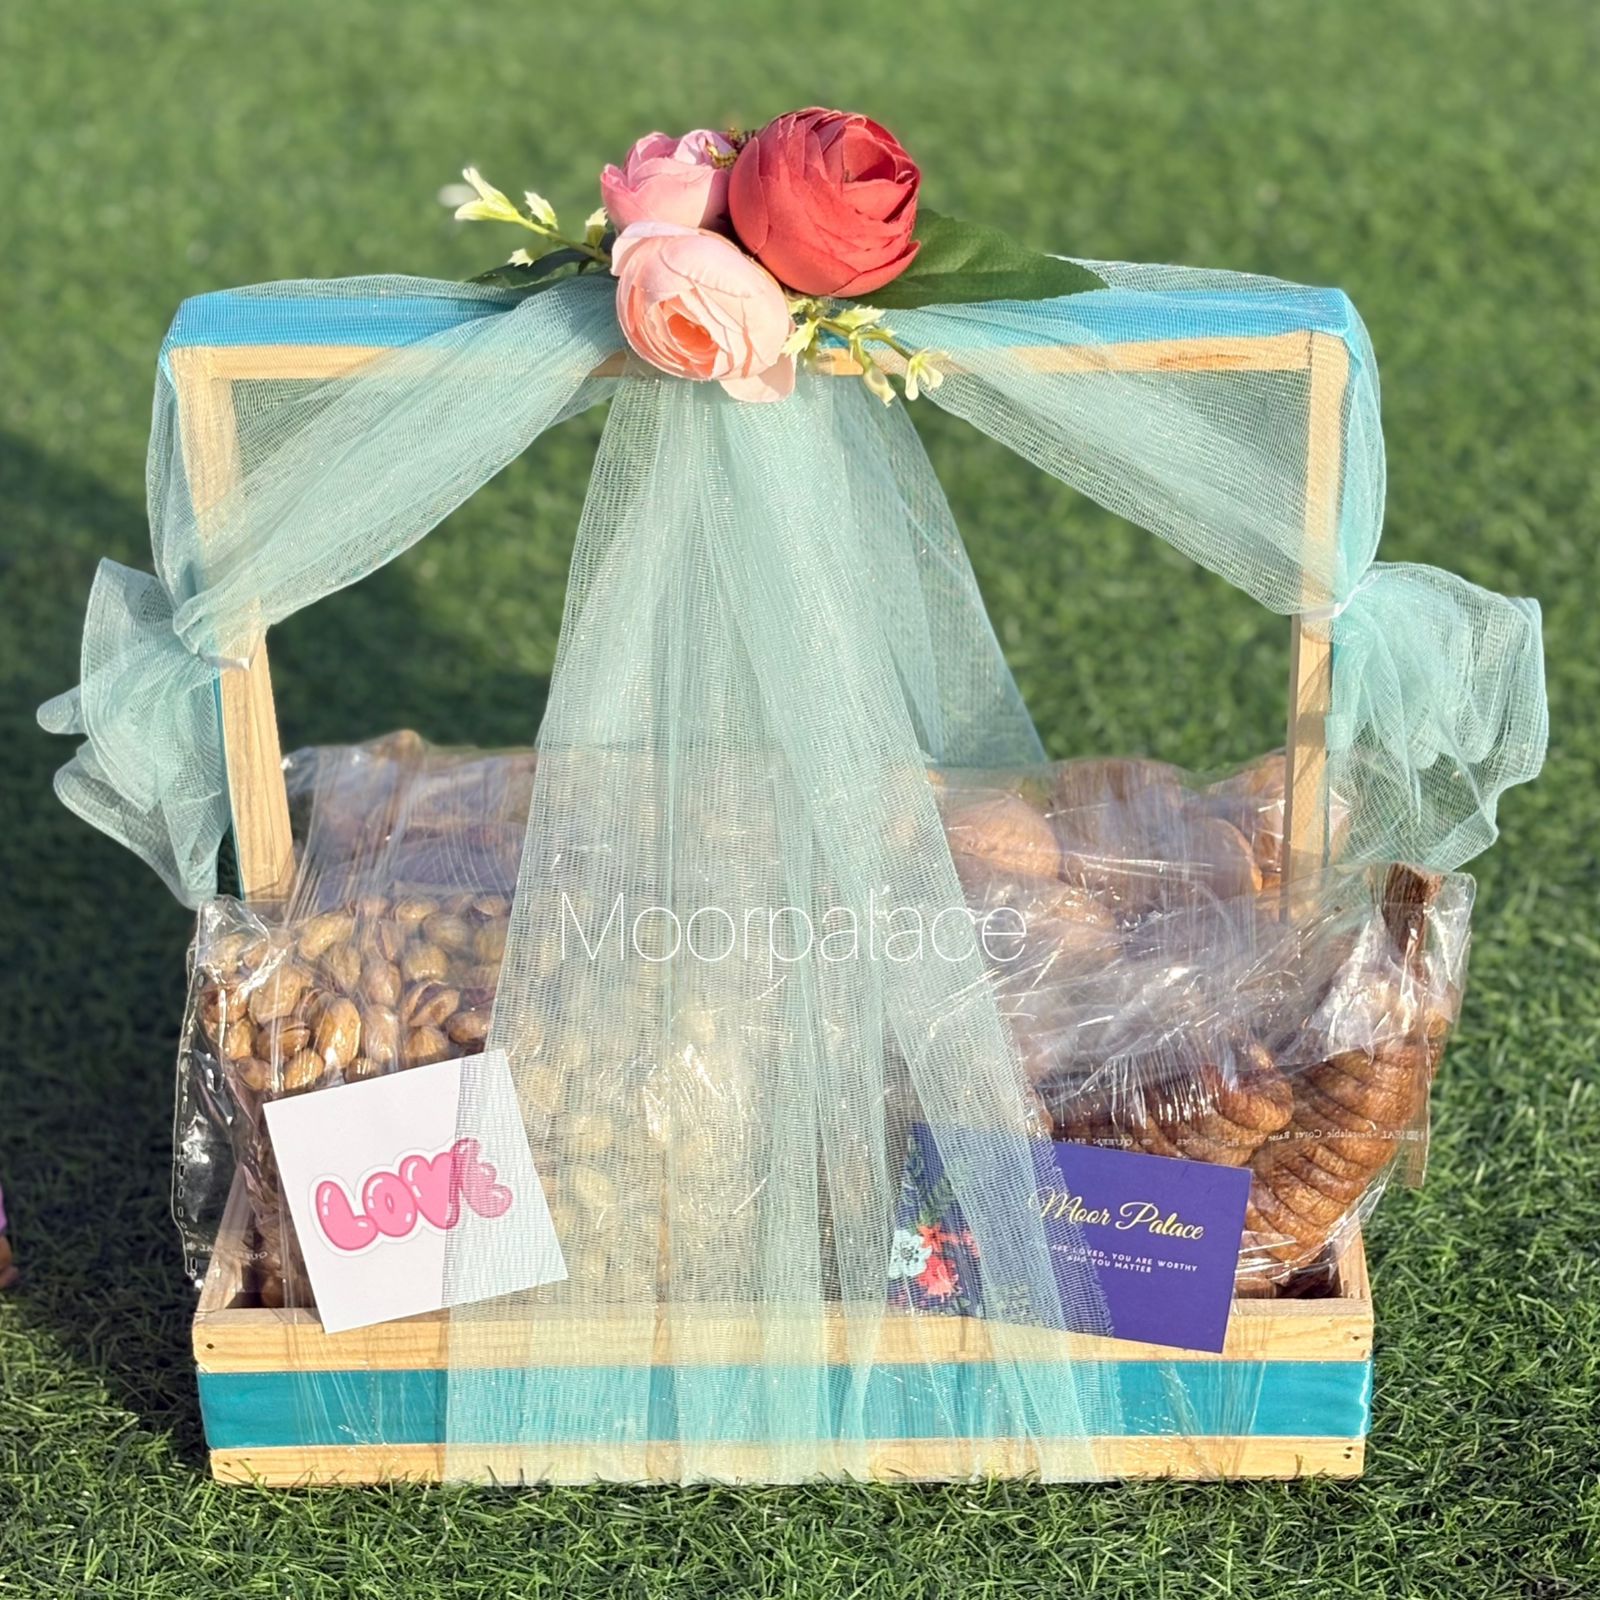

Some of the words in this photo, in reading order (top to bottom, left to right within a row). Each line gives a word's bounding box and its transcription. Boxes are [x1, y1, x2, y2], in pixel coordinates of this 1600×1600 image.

[315, 1137, 513, 1251] LOVE
[1028, 1186, 1111, 1226] Moor
[1115, 1201, 1205, 1240] Palace
[1072, 1246, 1108, 1260] LOVED,
[1111, 1252, 1132, 1263] YOU
[1135, 1256, 1153, 1266] ARE
[1157, 1260, 1198, 1273] WORTHY
[1091, 1258, 1111, 1268] YOU
[1114, 1261, 1153, 1274] MATTER
